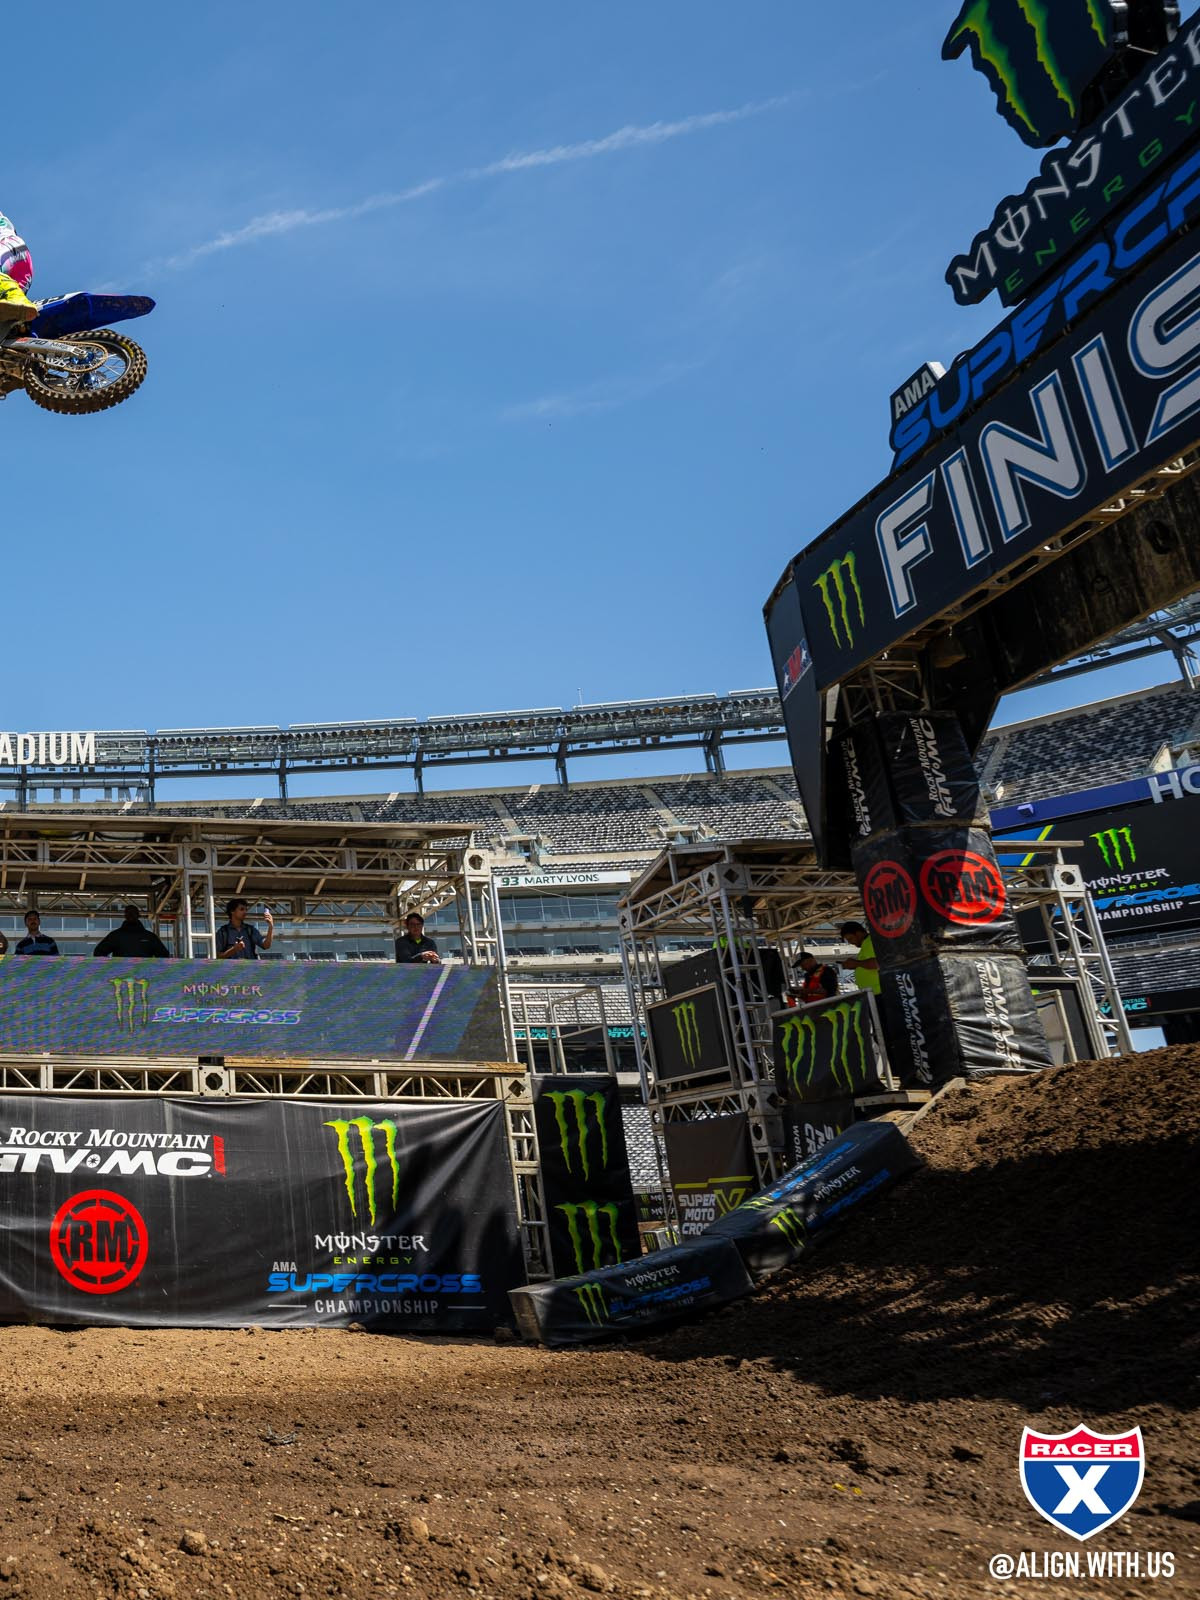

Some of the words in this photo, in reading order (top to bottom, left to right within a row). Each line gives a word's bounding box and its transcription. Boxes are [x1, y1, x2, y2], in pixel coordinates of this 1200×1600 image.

[1004, 101, 1196, 293] ENERGY
[895, 371, 936, 419] AMA
[908, 718, 930, 769] MOUNTAIN
[502, 877, 519, 886] 93
[525, 875, 564, 885] MARTY
[566, 873, 600, 883] LYONS
[1084, 868, 1171, 890] MONSTER
[1098, 881, 1158, 895] ENERGY
[1095, 900, 1185, 921] HAMPIONSHIP
[183, 983, 263, 997] MONSTER
[974, 961, 999, 1021] MOUNTAIN
[895, 974, 914, 1031] MOUNTAIN
[152, 1007, 303, 1024] SUPERCROSS
[8, 1127, 83, 1147] ROCKY
[87, 1128, 211, 1150] MOUNTAIN
[812, 1165, 862, 1203] MONSTER
[678, 1193, 716, 1207] SUPER
[685, 1208, 715, 1221] MOTO
[69, 1220, 130, 1264] RM
[314, 1231, 429, 1252] MONSTER
[272, 1262, 298, 1272] AMA
[333, 1256, 414, 1265] ENERGY
[264, 1273, 483, 1293] SUPERCROSS
[623, 1264, 681, 1288] MONSTER
[314, 1300, 439, 1314] CHAMPIONSHIP
